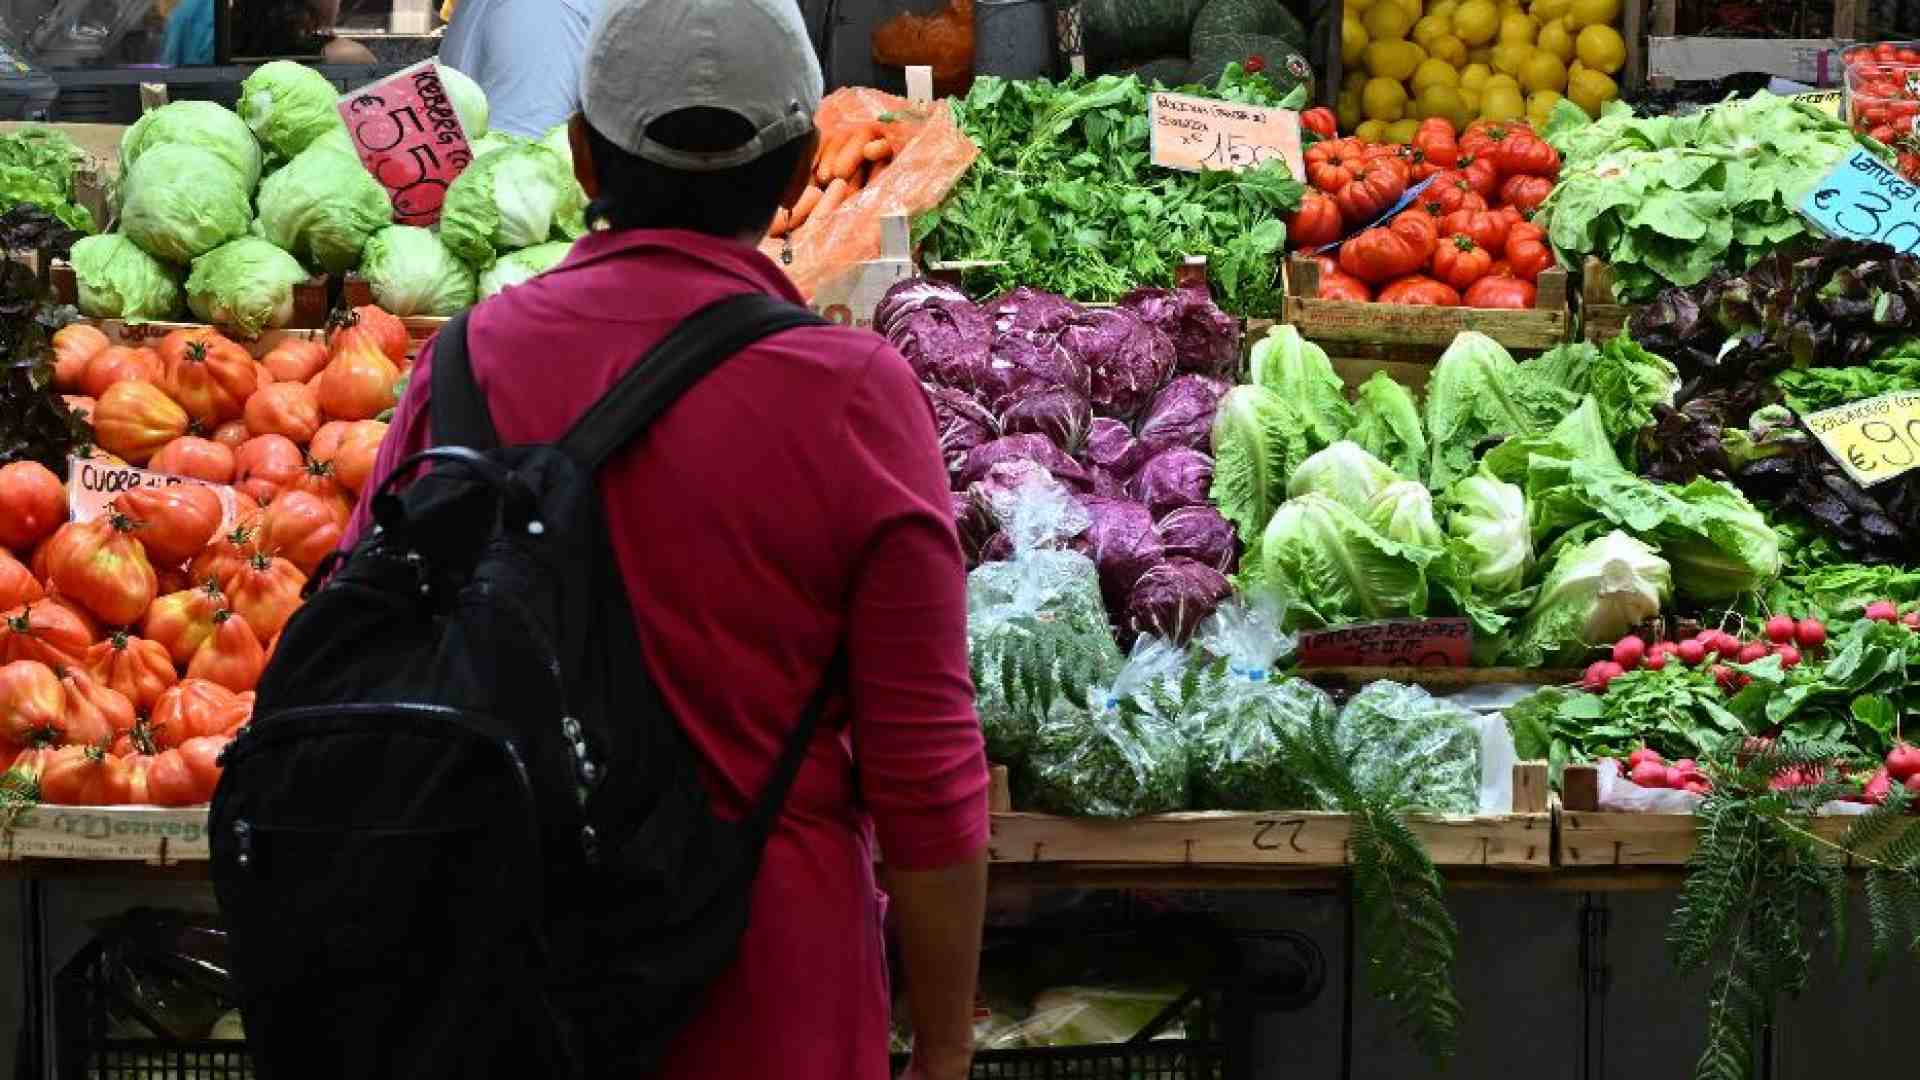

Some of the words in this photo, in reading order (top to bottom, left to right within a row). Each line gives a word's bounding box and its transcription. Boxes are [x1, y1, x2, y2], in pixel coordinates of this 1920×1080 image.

[351, 94, 385, 114] €
[1814, 188, 1841, 211] €
[1847, 443, 1878, 472] €
